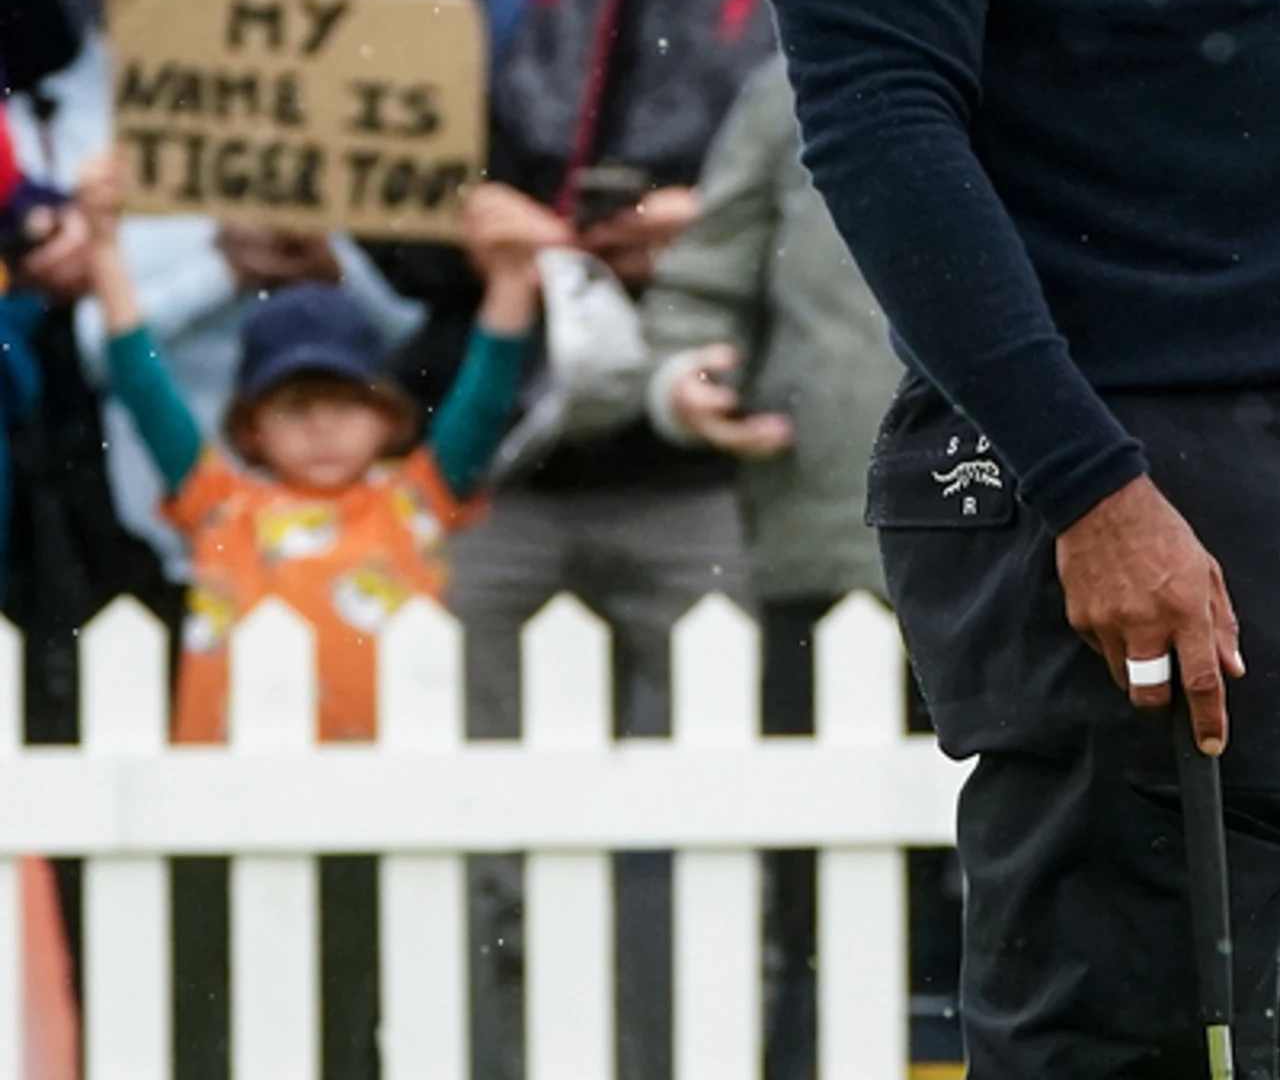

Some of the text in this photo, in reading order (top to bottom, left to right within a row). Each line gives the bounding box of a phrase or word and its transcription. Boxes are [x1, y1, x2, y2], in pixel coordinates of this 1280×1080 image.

[117, 62, 441, 137] NAME IS
[124, 127, 324, 210] TIGER
[946, 435, 960, 456] S
[963, 495, 977, 515] R
